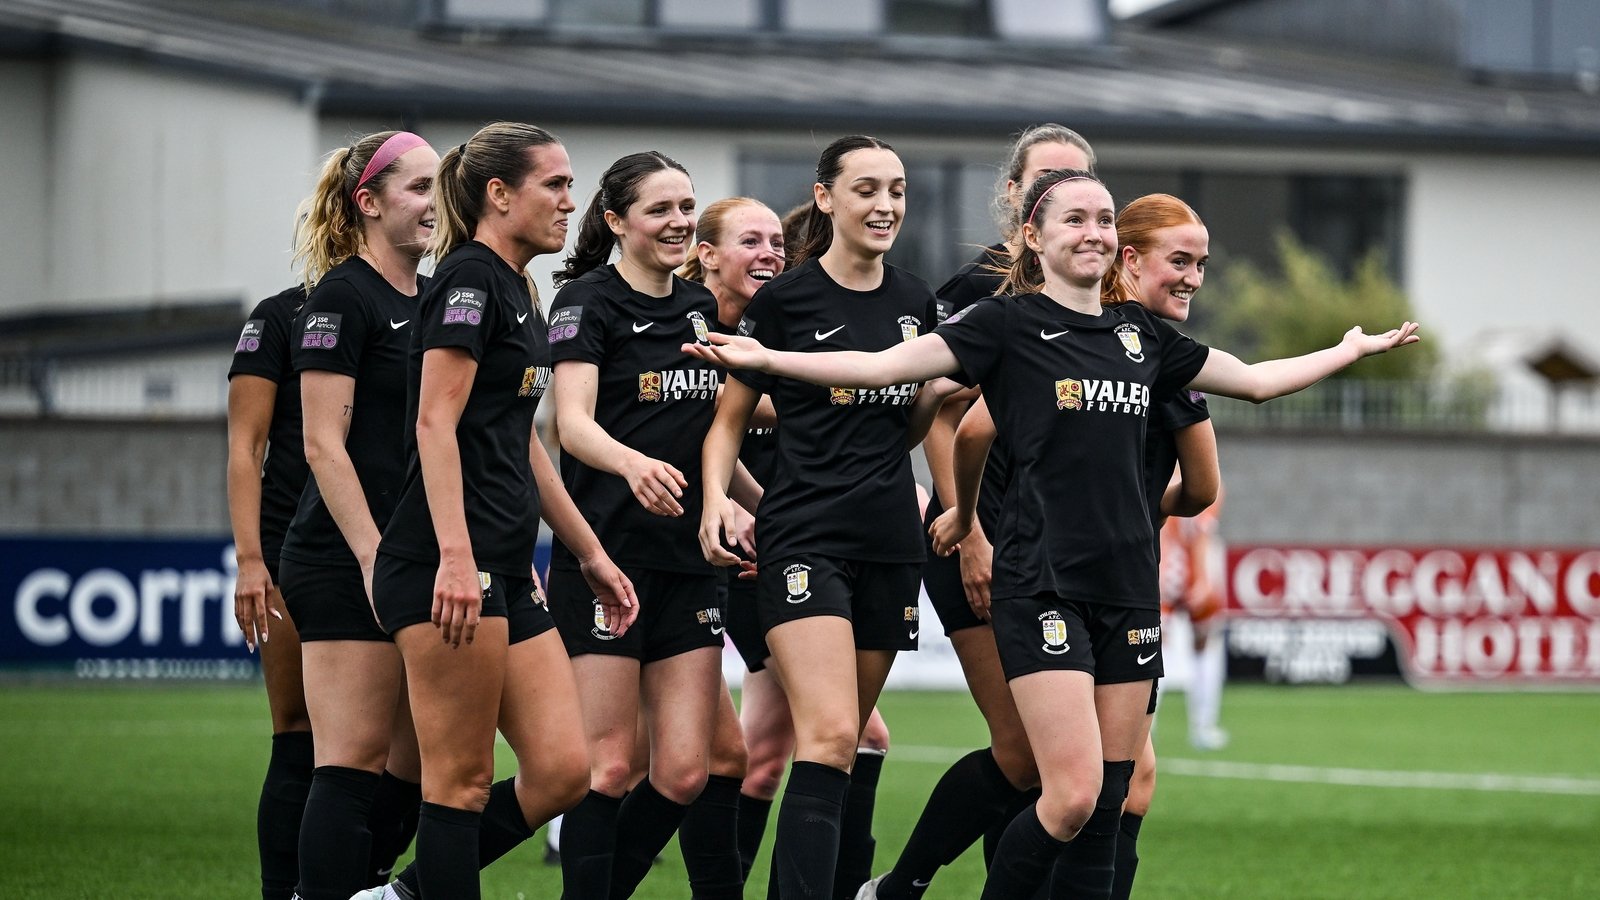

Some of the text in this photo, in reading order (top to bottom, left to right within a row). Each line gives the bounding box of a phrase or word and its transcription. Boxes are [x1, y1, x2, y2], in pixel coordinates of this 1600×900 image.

[661, 369, 718, 391] VALEO
[1082, 379, 1149, 407] VALEO
[1086, 401, 1147, 417] FUTBOL
[1233, 549, 1557, 619] CREGGAN
